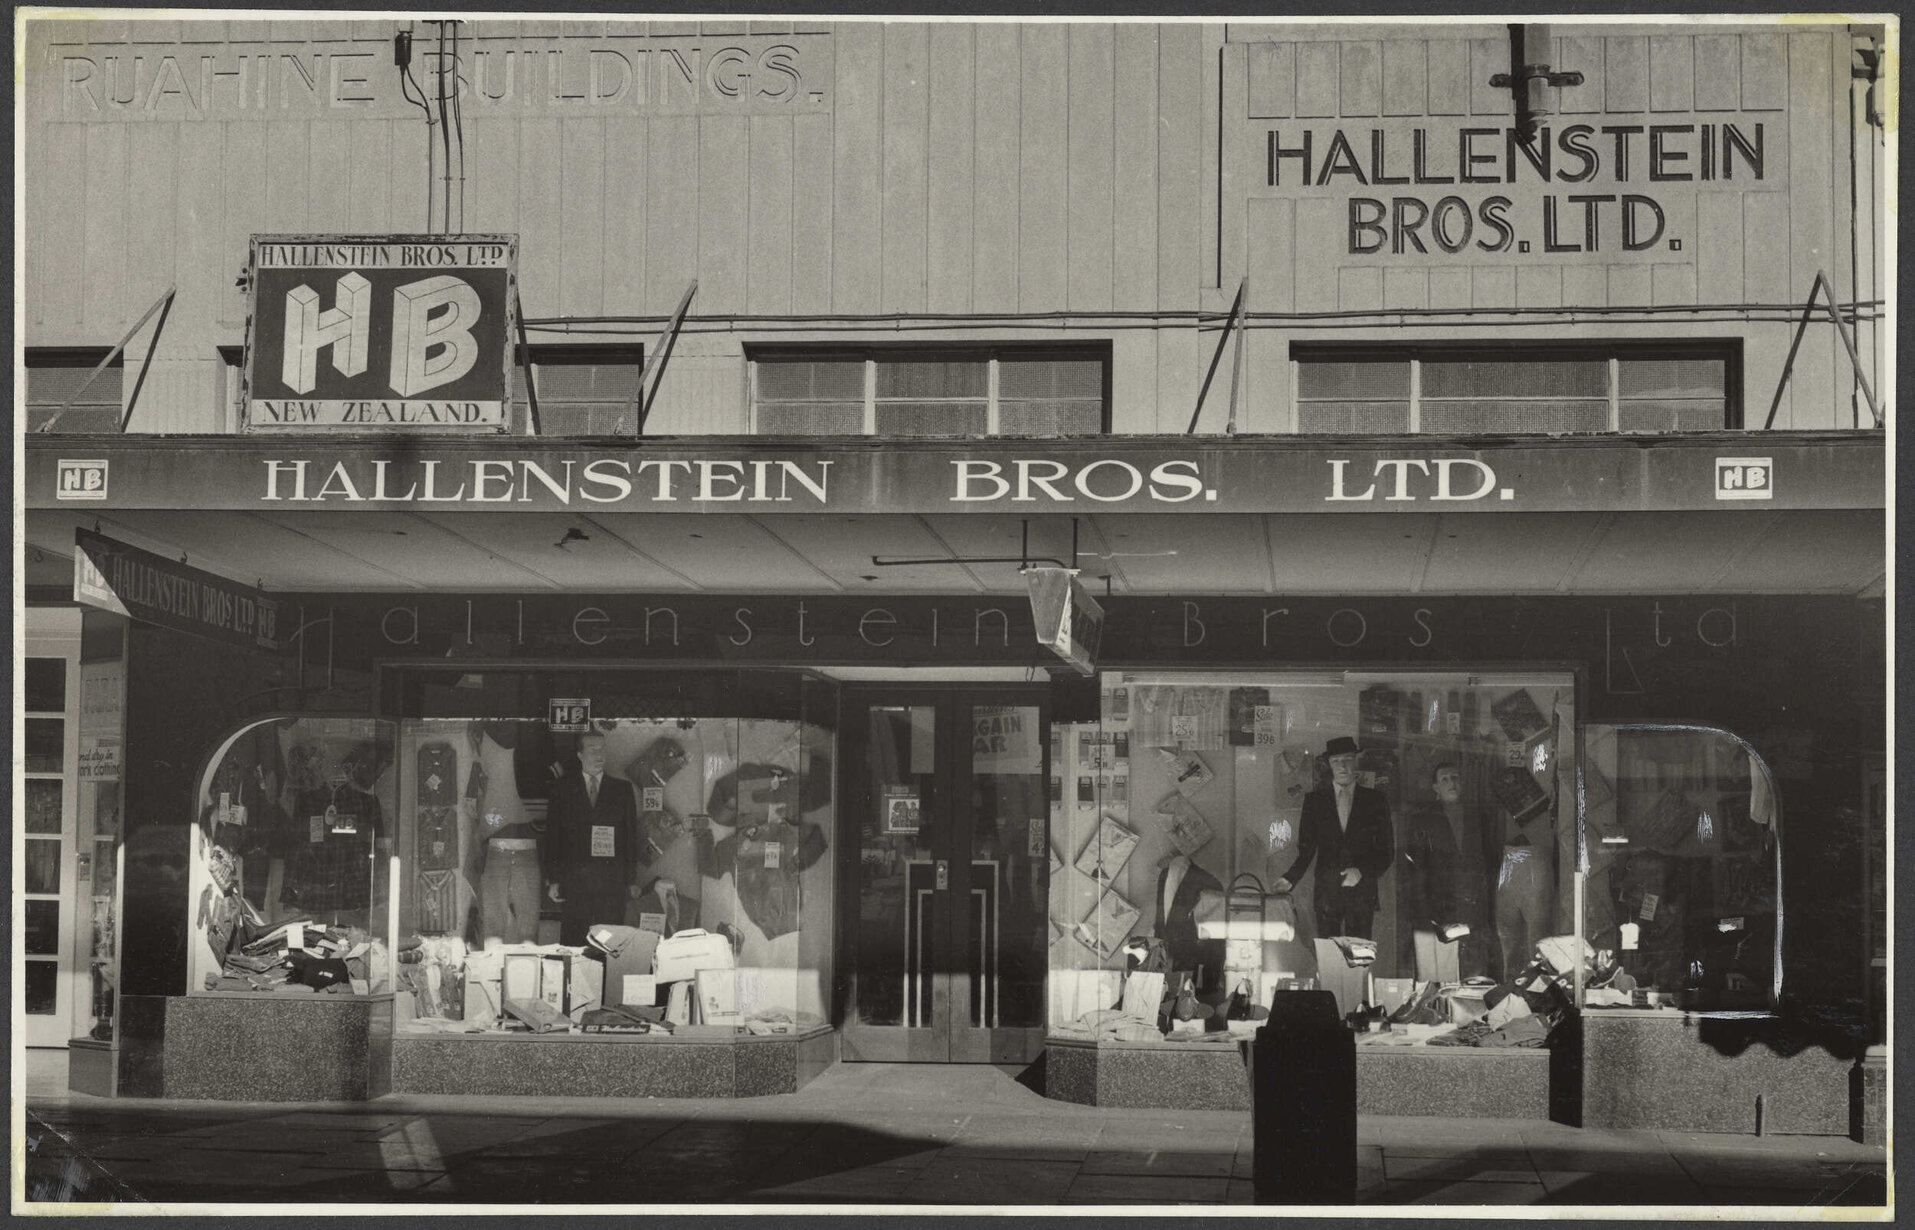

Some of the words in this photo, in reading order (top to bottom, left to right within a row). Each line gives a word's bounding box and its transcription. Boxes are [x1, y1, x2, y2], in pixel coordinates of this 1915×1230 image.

[63, 53, 375, 110] RUAHINE
[423, 45, 824, 104] BUILDINGS.
[1267, 123, 1764, 186] HALLENSTEIN
[261, 245, 391, 267] HALLENSTEIN
[401, 245, 458, 266] BROS.
[281, 270, 482, 399] HB
[263, 401, 322, 423] NEW
[341, 401, 488, 423] ZEALAND.
[64, 467, 102, 491] HB
[261, 459, 834, 504] HALLENSTEIN
[949, 459, 1217, 502] BROS.
[1324, 458, 1515, 501] LTD.
[1723, 465, 1766, 490] HB
[113, 554, 199, 620] HALLENSTEIN
[1182, 601, 1433, 648] Bros
[555, 703, 584, 724] HB
